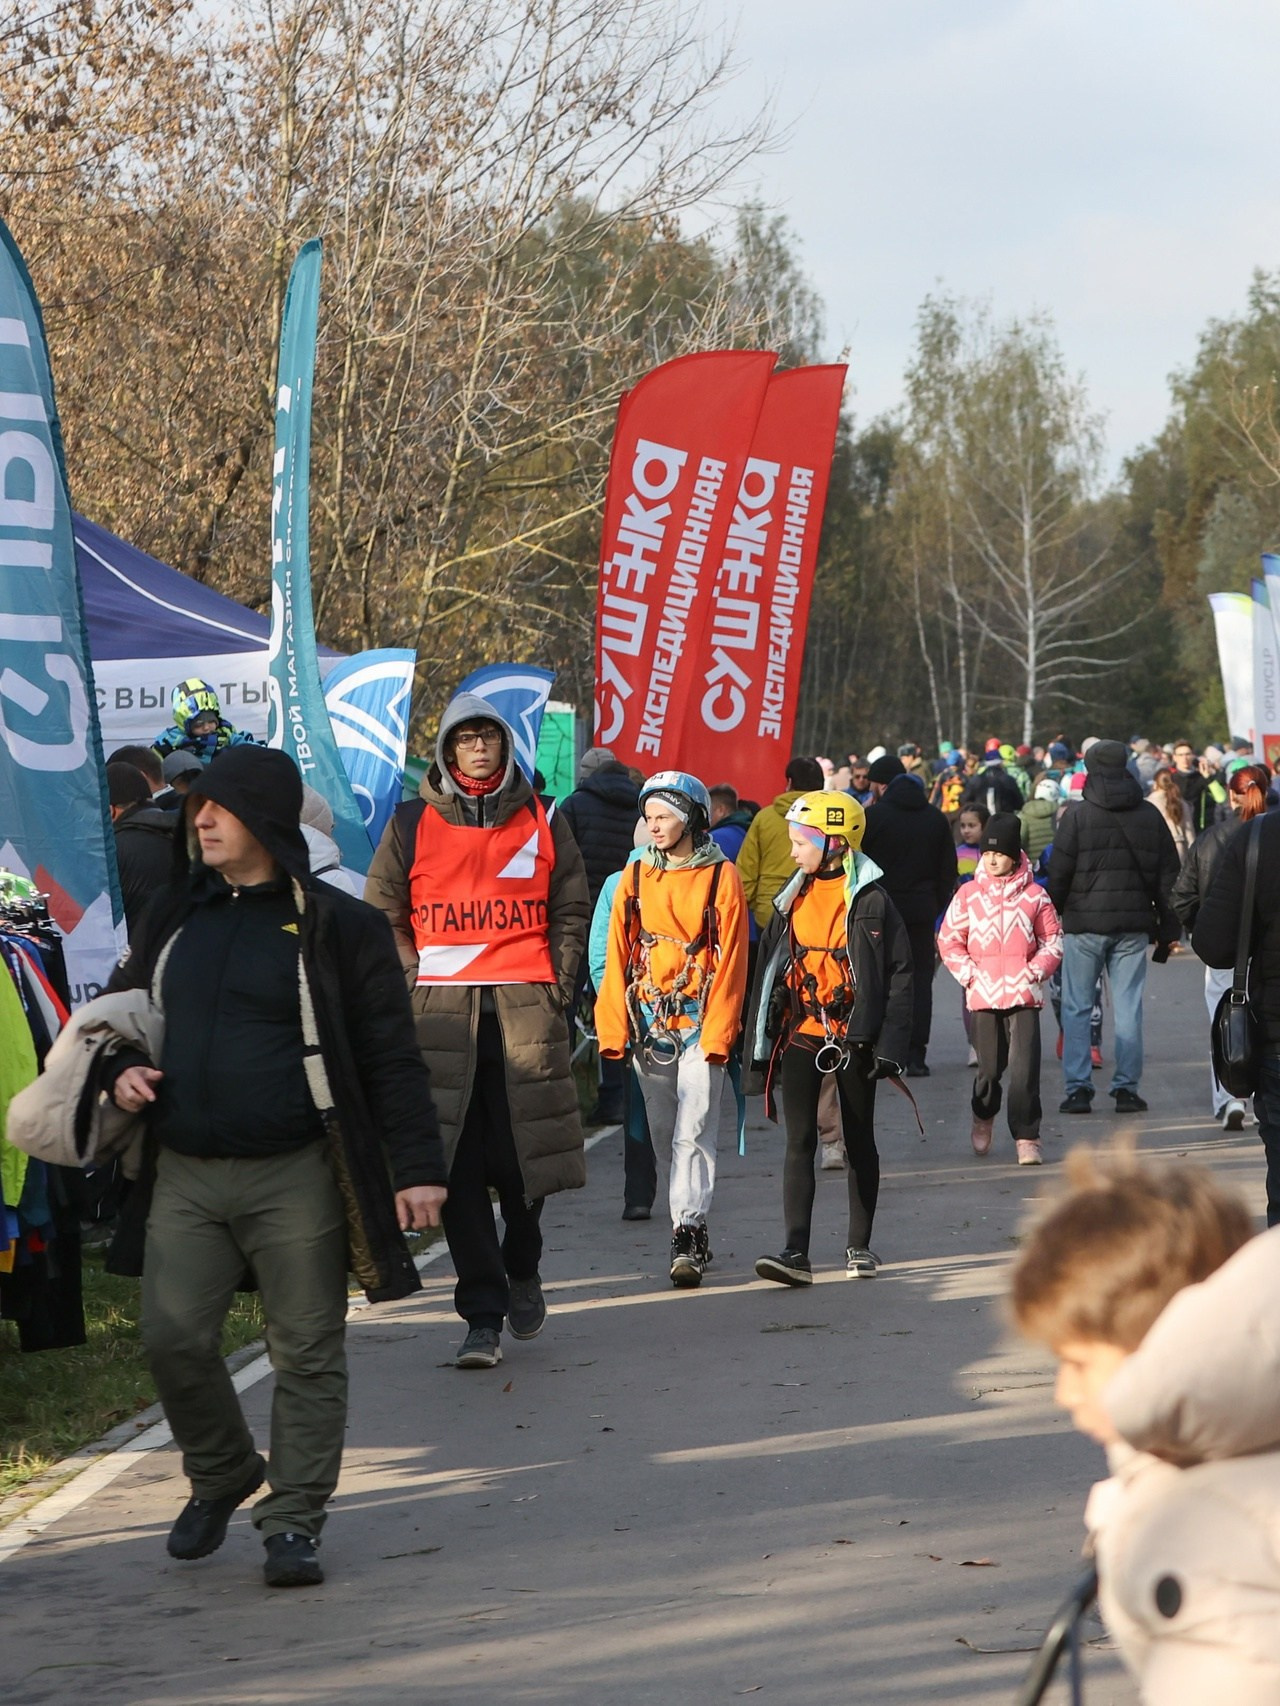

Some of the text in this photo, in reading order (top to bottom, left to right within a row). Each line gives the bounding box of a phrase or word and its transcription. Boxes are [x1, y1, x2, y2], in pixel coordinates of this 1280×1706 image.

[283, 571, 299, 697] МАГАЗИН
[635, 456, 727, 758] ЭКСПЕДИЦИОННАЯ
[757, 465, 814, 740] ЭКСПЕДИЦИОННАЯ
[287, 707, 316, 775] ТВОЙ
[828, 810, 843, 823] 22
